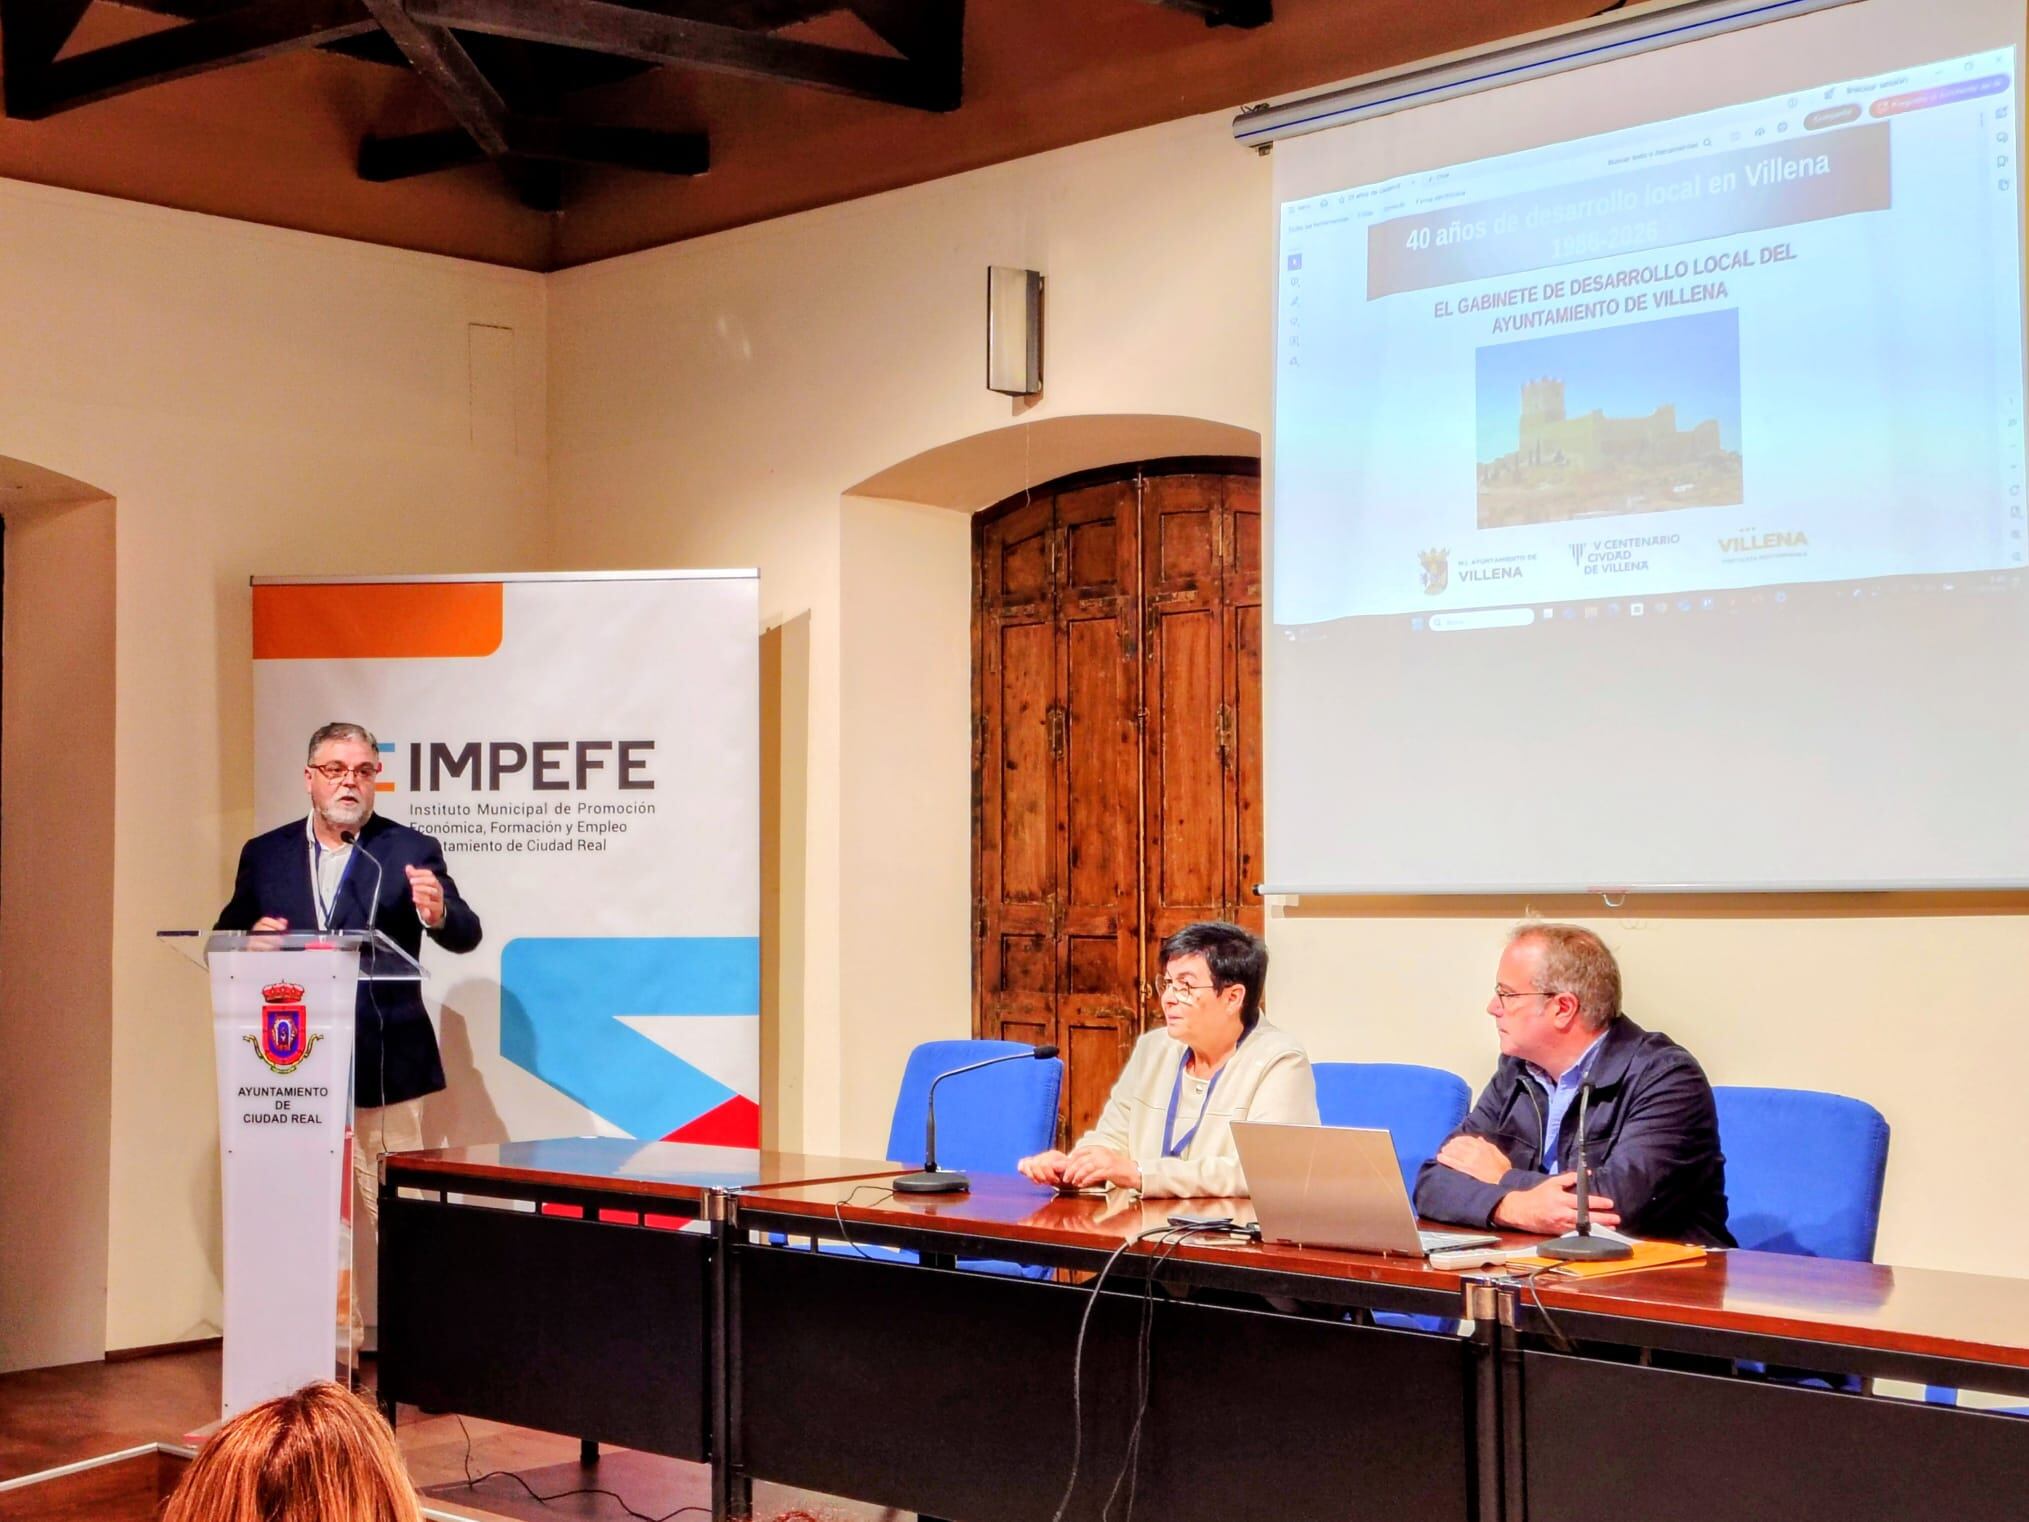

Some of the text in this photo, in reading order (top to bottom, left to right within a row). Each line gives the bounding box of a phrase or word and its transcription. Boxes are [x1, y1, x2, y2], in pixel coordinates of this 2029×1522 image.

[1405, 154, 1831, 251] 40 años de desarrollo local en Villena
[1434, 242, 1798, 318] EL GABINETE DE DESARROLLO LOCAL DEL
[1492, 280, 1729, 335] AYUNTAMIENTO DE VILLENA
[1604, 534, 1681, 550] CENTENARIO
[1717, 531, 1808, 552] VILLENA
[1458, 566, 1524, 582] VILLENA
[1584, 560, 1649, 575] DE VILLENA
[409, 740, 655, 792] IMPEFE
[410, 801, 656, 818] Instituto Municipal de Promoción
[410, 820, 628, 836] Económica, Formación y Empleo
[443, 838, 607, 852] tamiento de Ciudad Real
[238, 1087, 329, 1097] AYUNTAMIENTO
[275, 1100, 291, 1111] DE
[243, 1113, 323, 1124] CIUDAD REAL
